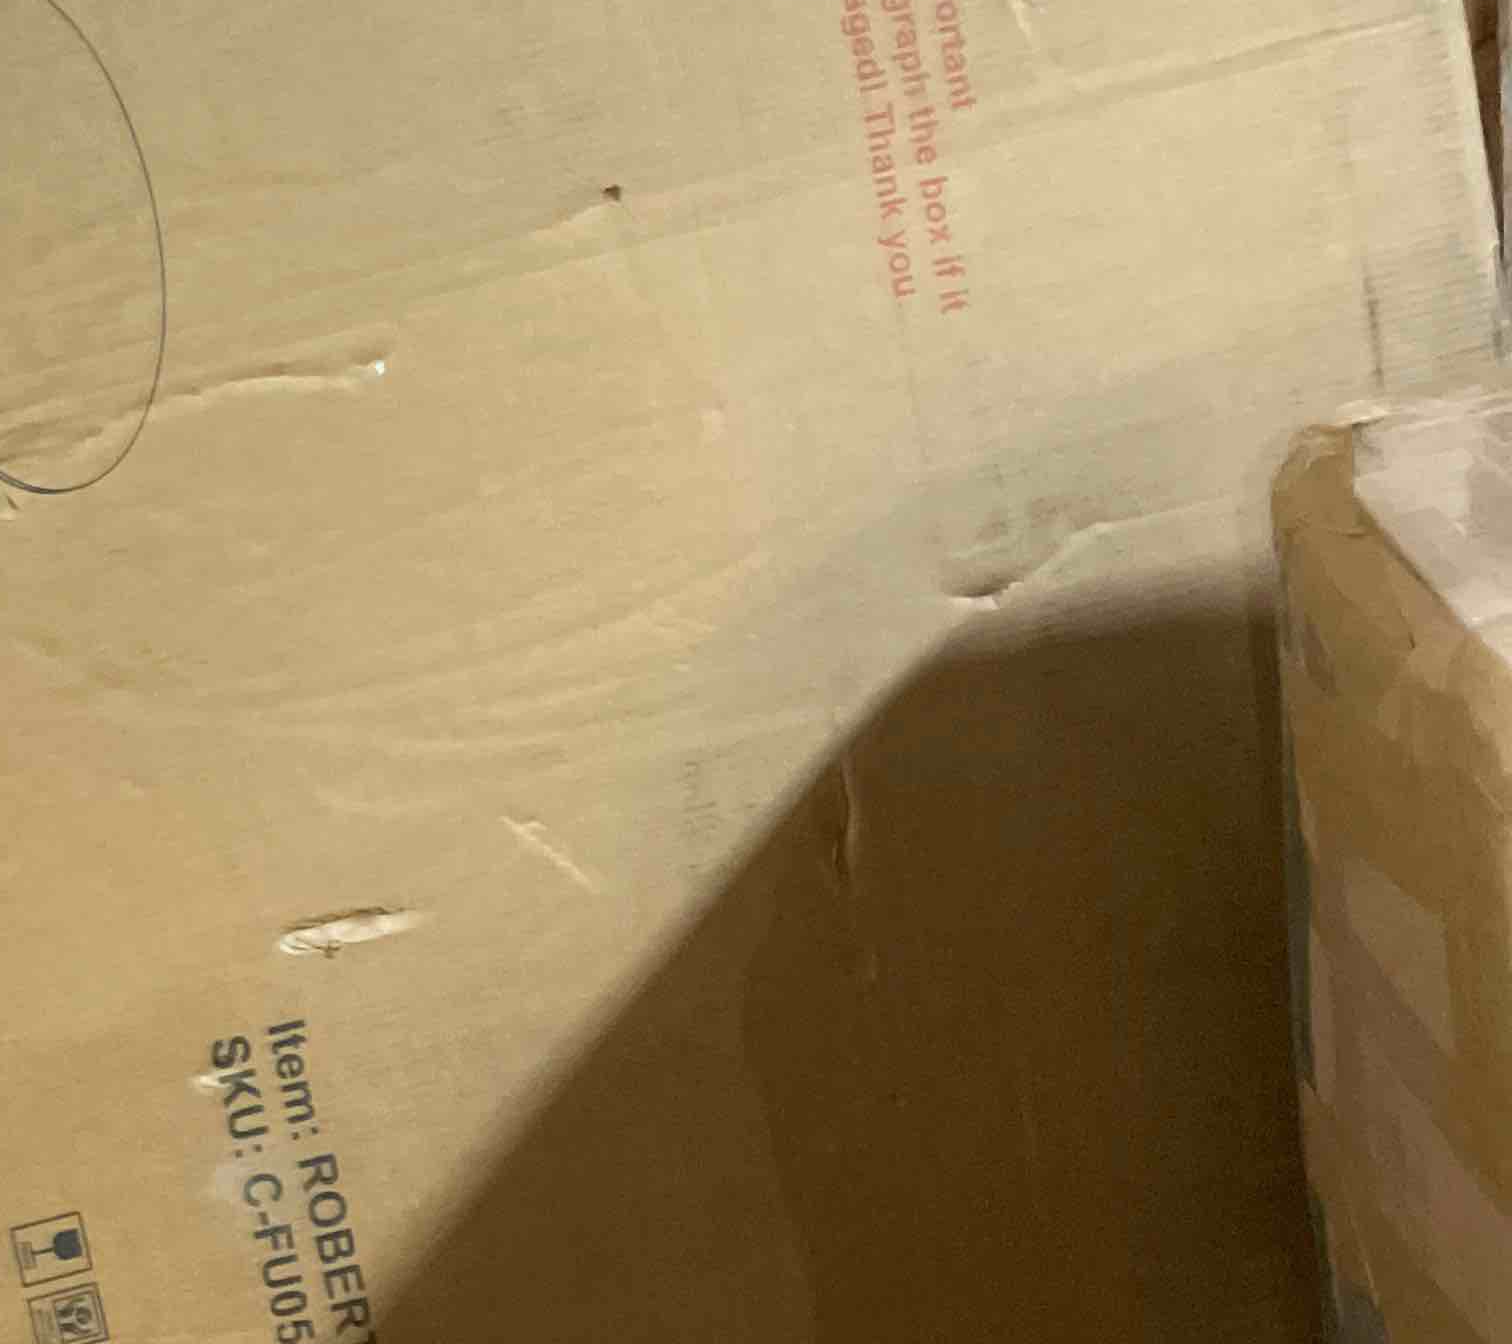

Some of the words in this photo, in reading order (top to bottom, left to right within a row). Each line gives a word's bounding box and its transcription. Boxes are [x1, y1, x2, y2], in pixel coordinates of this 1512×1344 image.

[863, 103, 908, 219] Thank
[908, 105, 940, 164] the
[918, 175, 951, 244] box
[931, 254, 966, 277] if
[938, 289, 970, 316] it
[211, 1034, 270, 1159] SKU:
[267, 1018, 320, 1141] Item:
